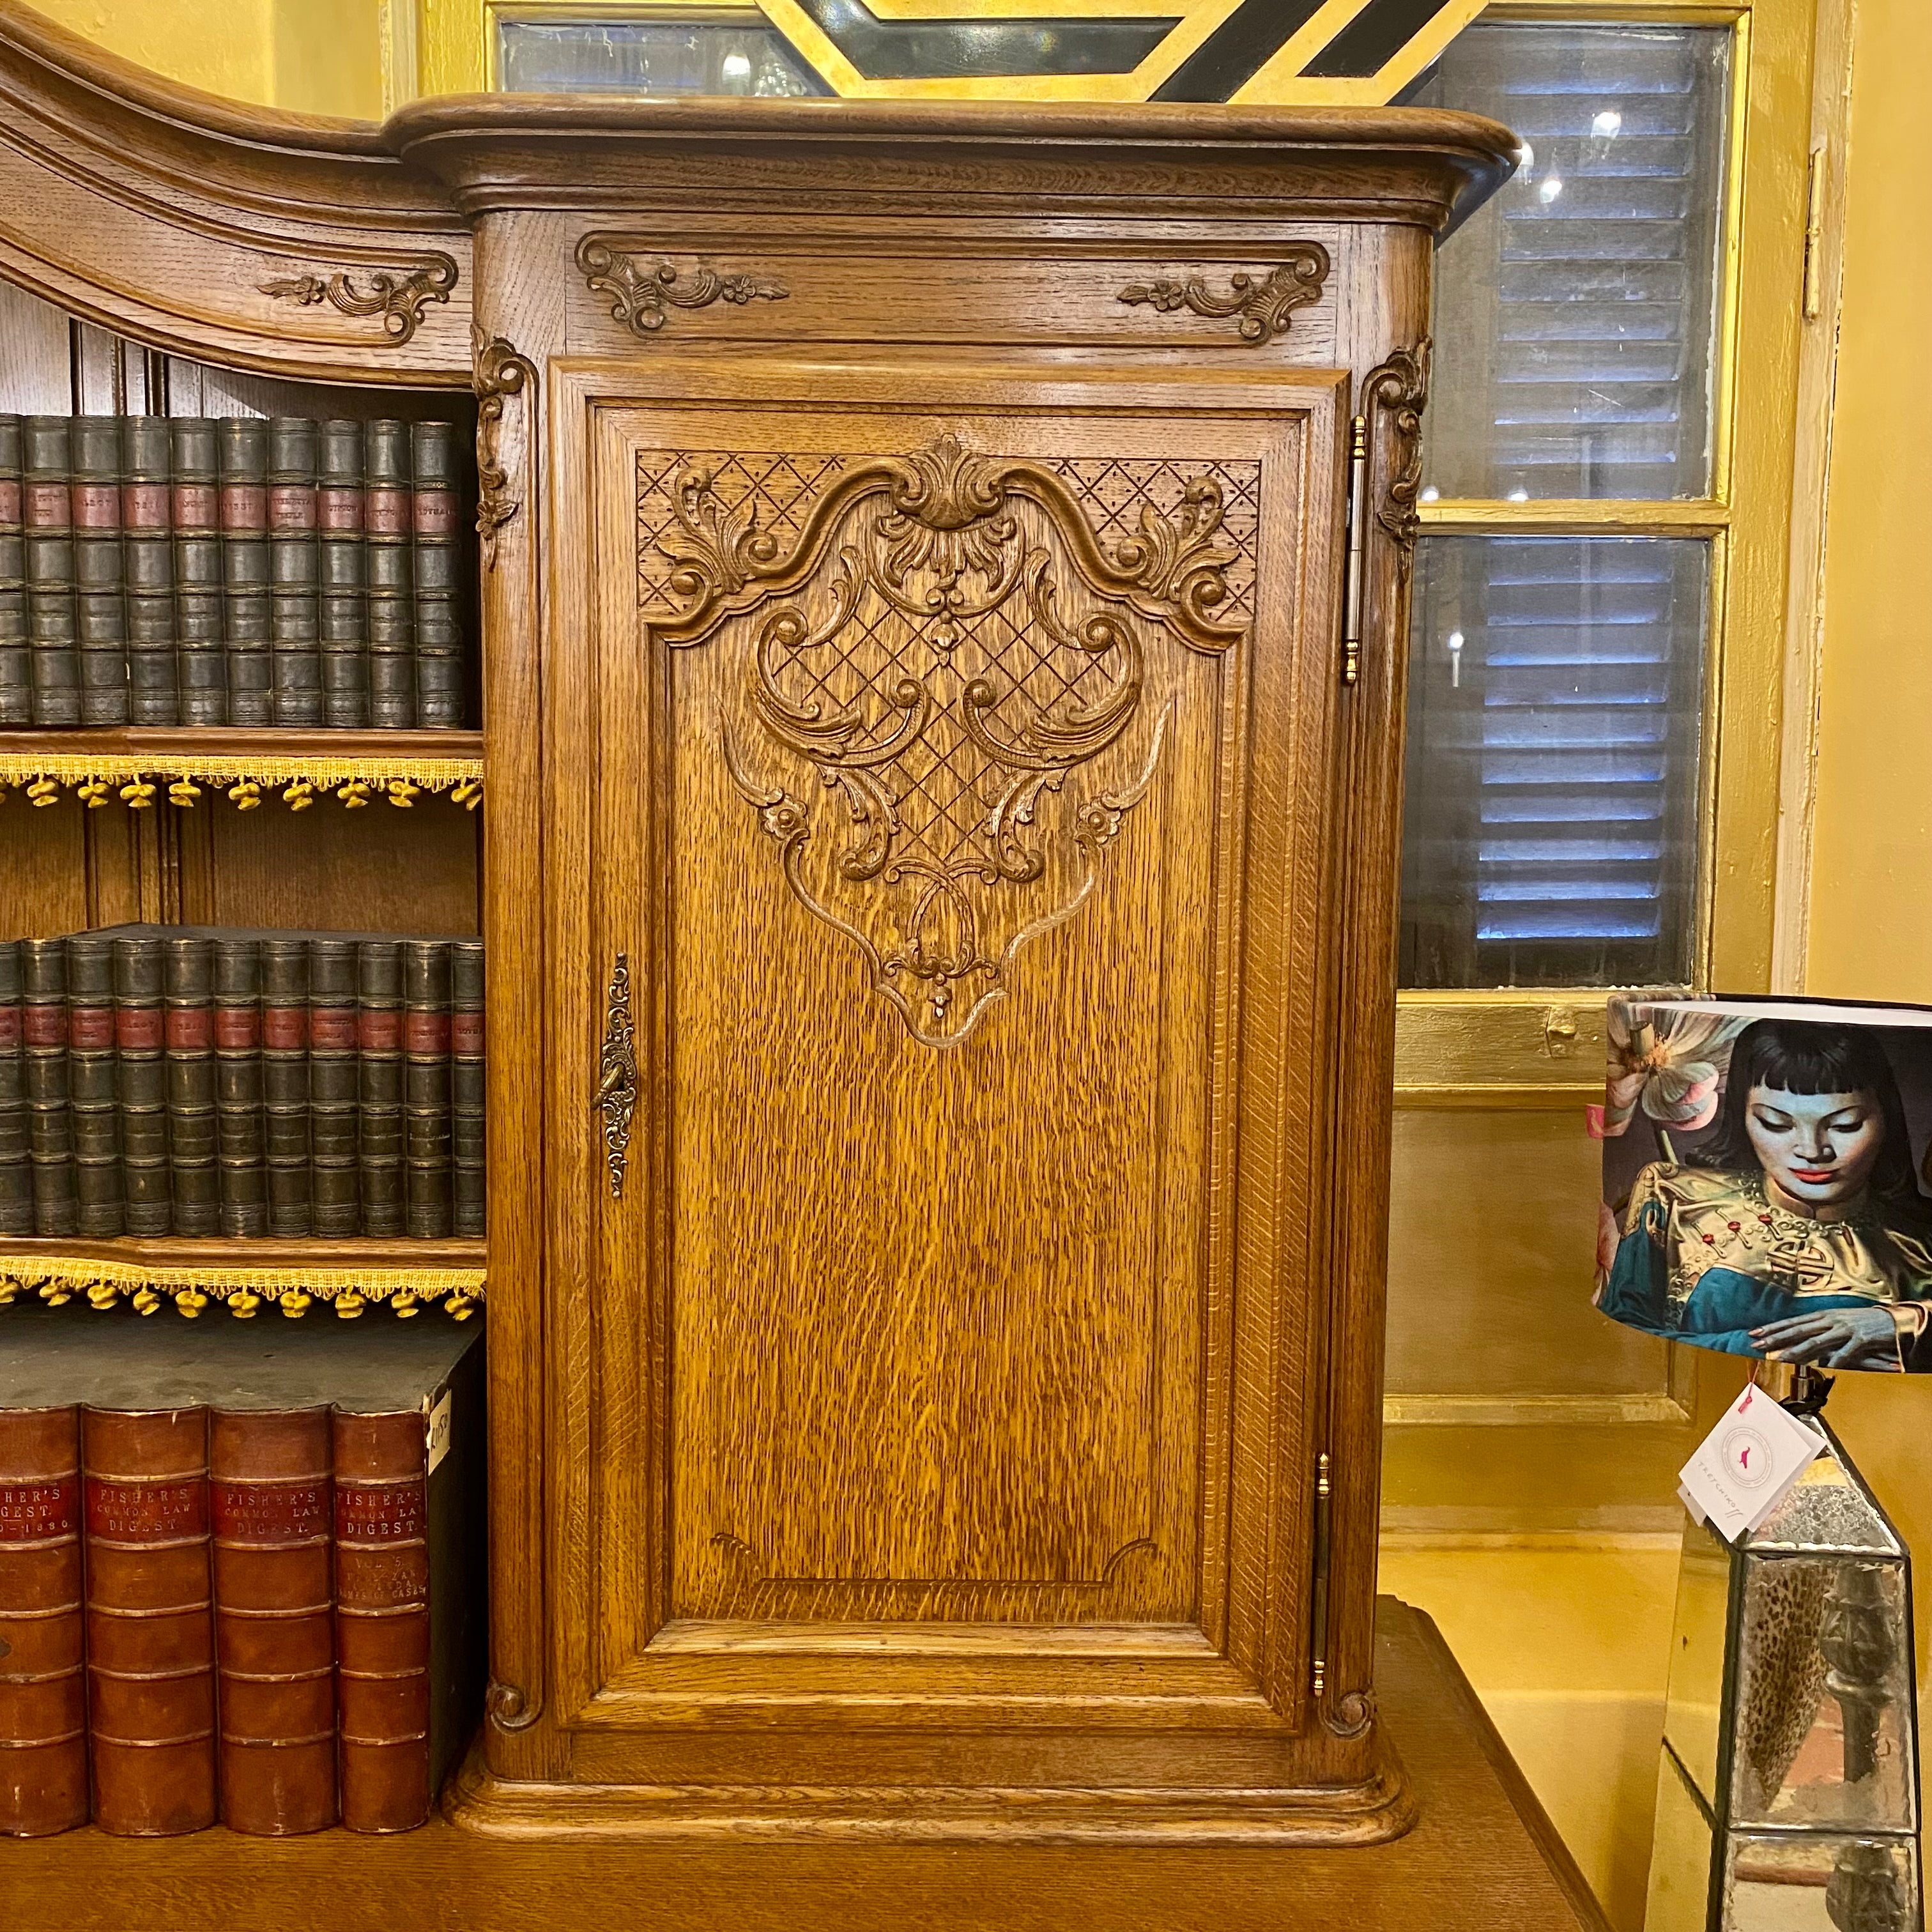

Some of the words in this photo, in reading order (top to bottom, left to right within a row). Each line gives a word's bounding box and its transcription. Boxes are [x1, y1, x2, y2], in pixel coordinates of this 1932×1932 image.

[227, 1491, 316, 1506] FISHER'S
[163, 1503, 190, 1515] LAW
[224, 1507, 279, 1519] COMMO
[292, 1505, 320, 1518] LAW
